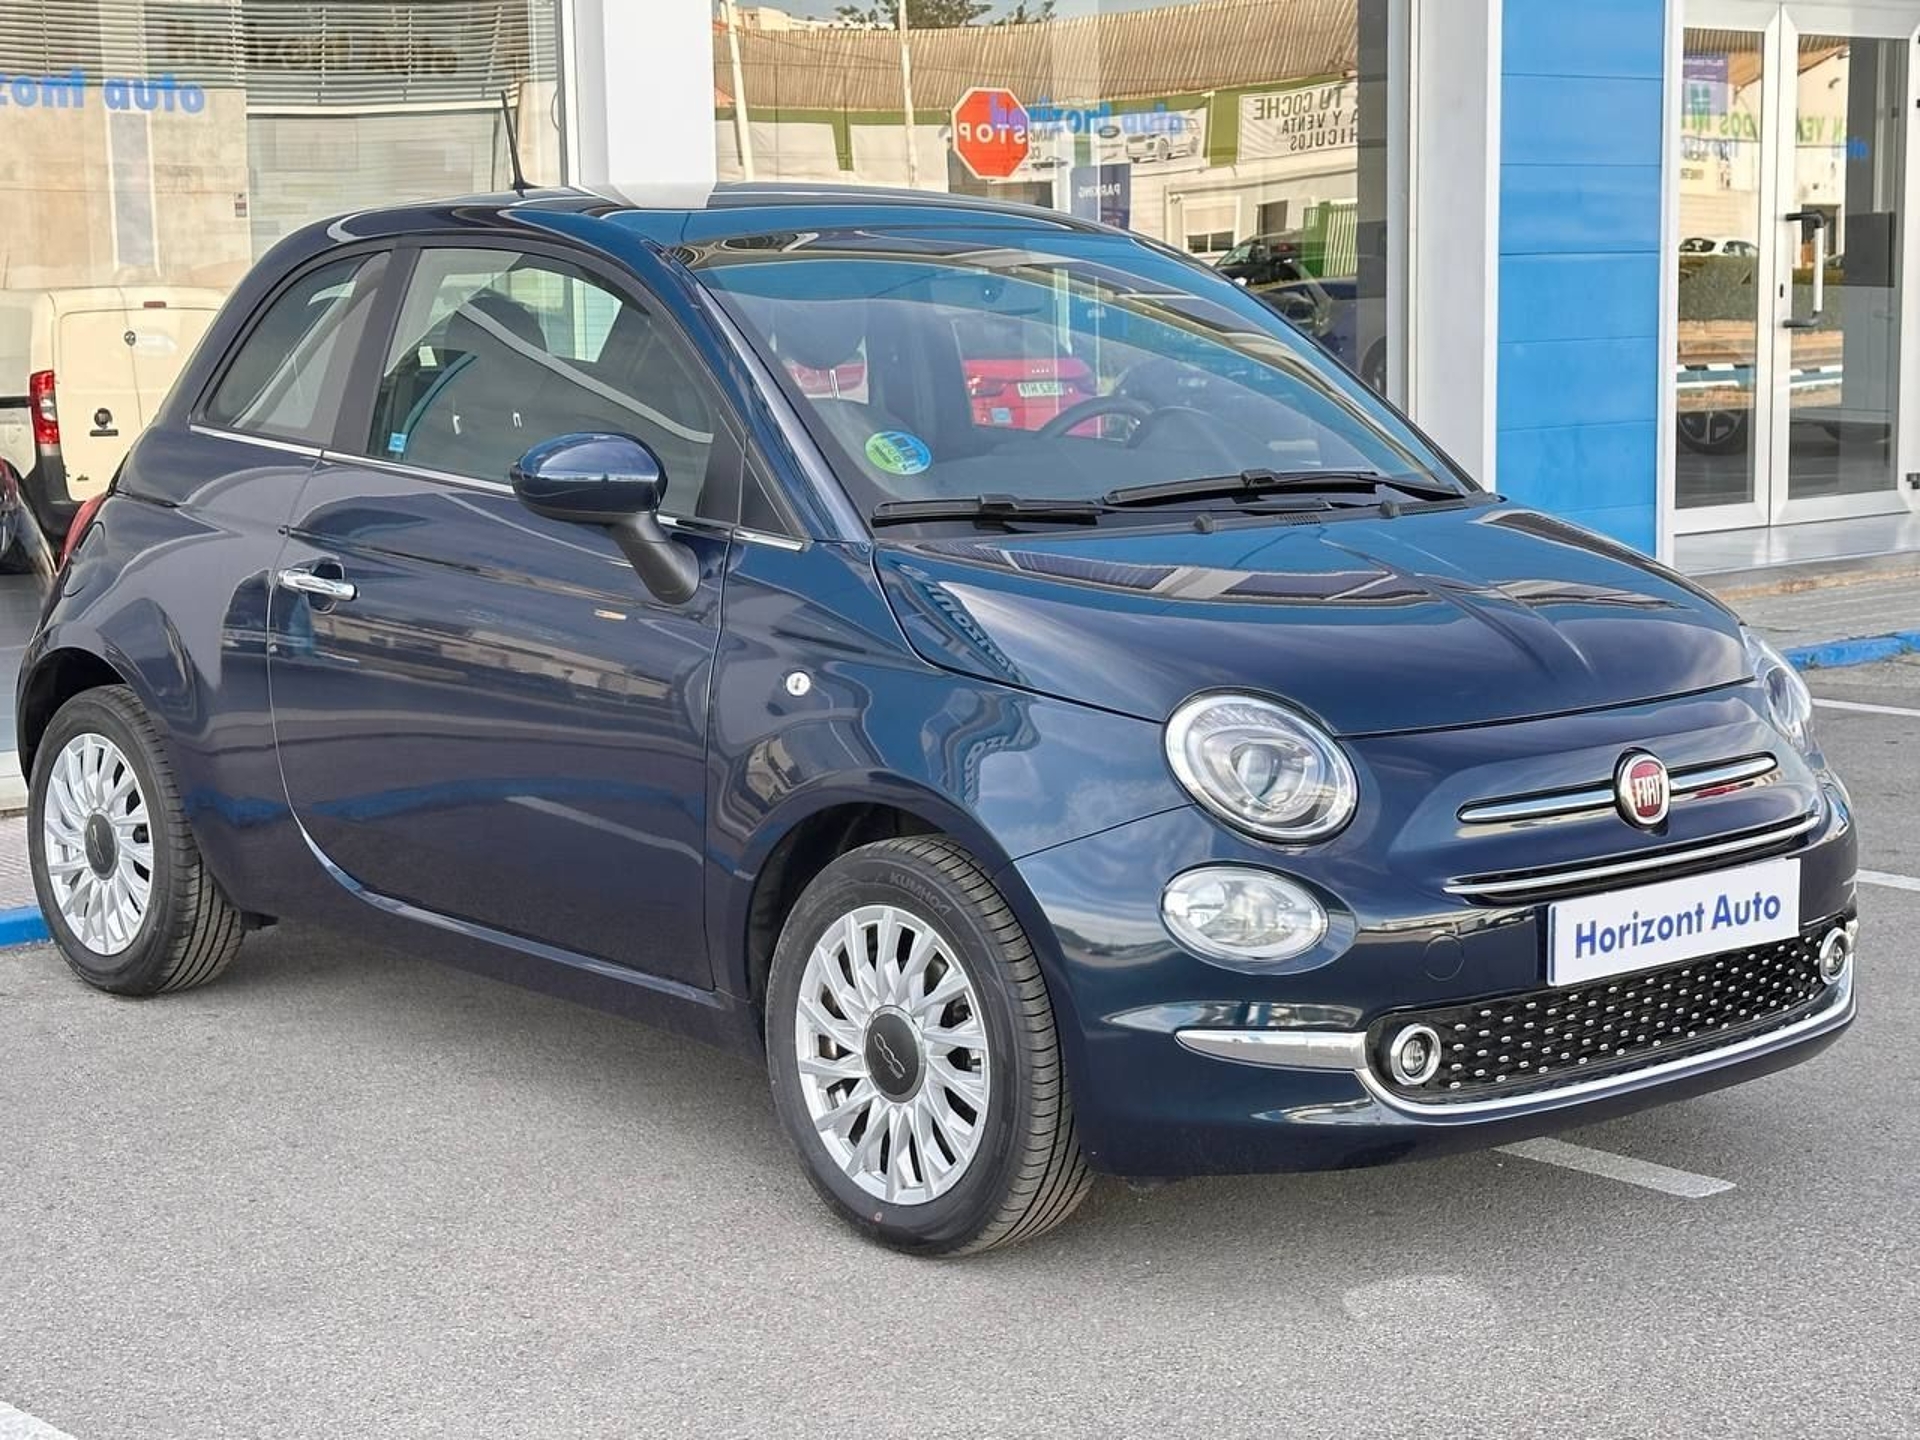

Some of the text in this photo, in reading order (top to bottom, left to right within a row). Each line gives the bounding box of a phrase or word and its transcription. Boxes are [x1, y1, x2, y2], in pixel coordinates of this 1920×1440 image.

[104, 73, 205, 114] auto
[1633, 774, 1662, 808] FIAT
[1575, 892, 1781, 958] Horizont Auto
